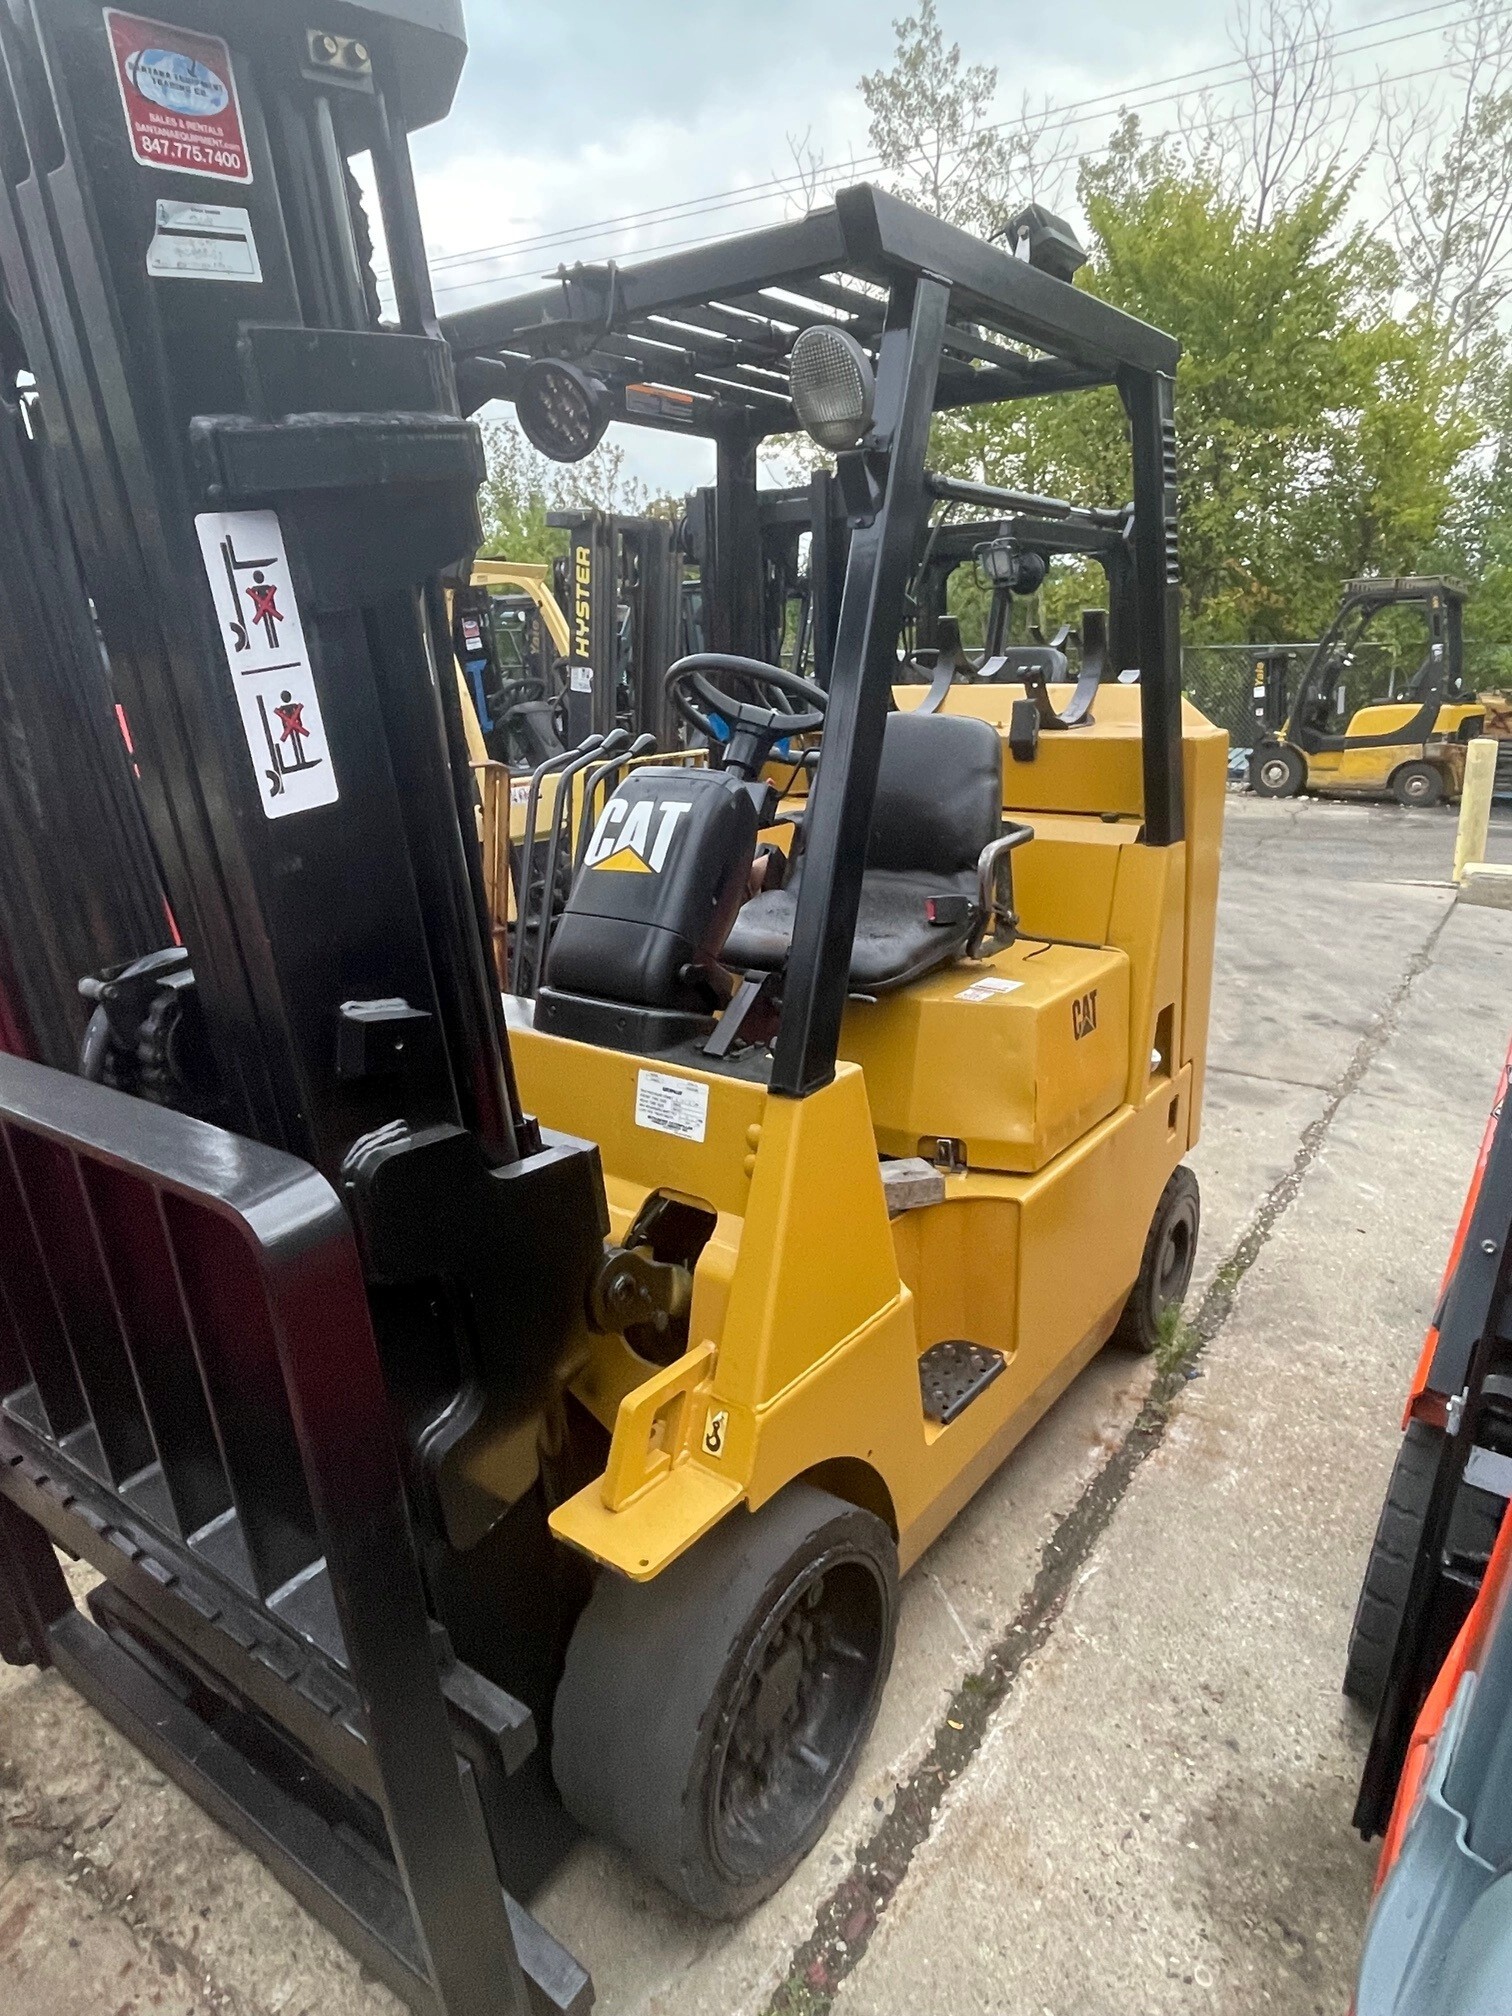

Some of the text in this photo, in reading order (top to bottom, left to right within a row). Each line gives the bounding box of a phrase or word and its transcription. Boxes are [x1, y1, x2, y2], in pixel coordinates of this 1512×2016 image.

[149, 112, 224, 137] SALES & RENTALS
[142, 136, 240, 169] 847.775.7400
[575, 546, 591, 659] HYSTER
[584, 798, 693, 874] CAT
[1072, 988, 1098, 1041] CAT
